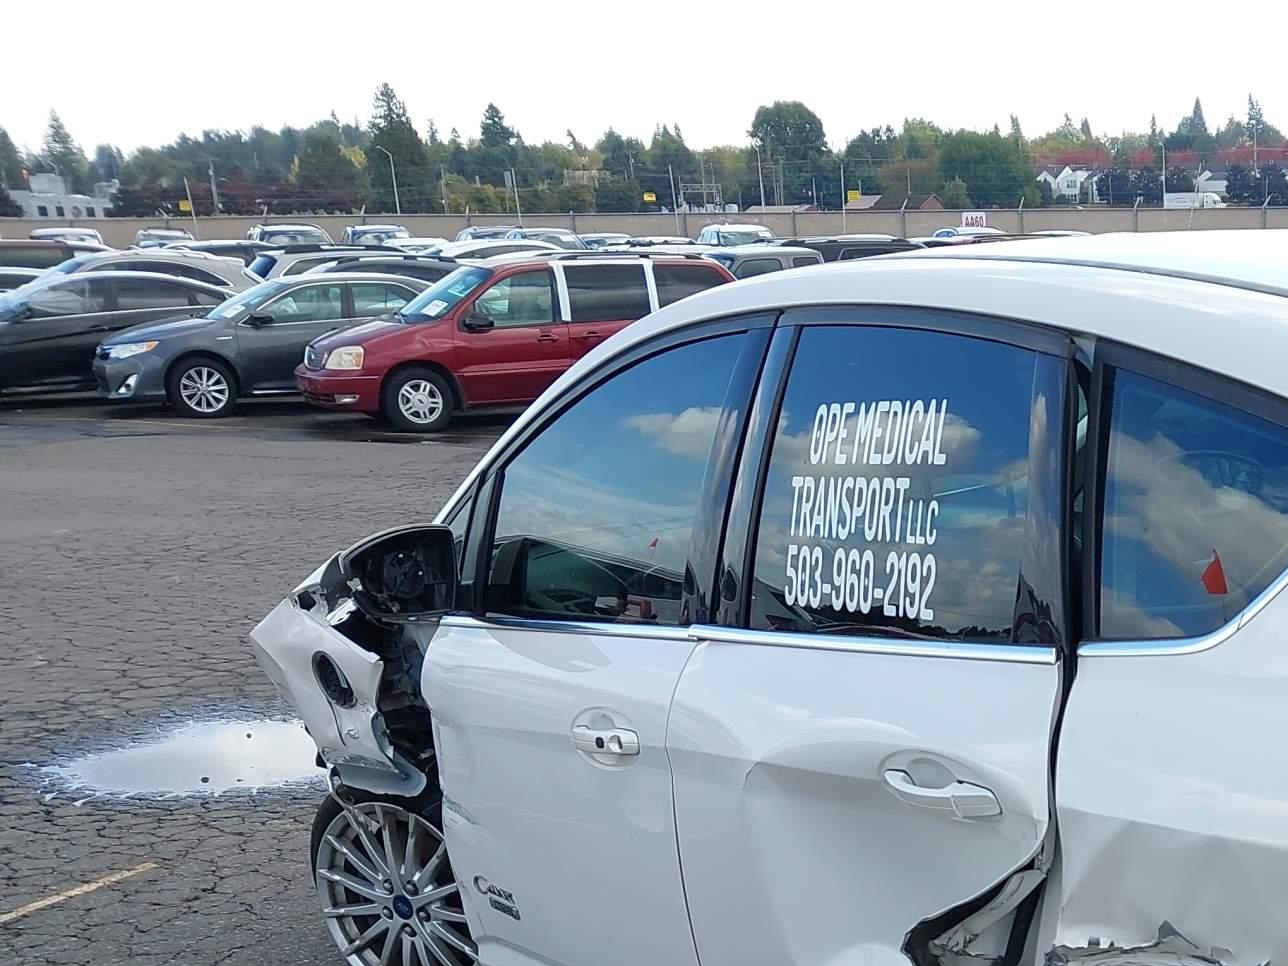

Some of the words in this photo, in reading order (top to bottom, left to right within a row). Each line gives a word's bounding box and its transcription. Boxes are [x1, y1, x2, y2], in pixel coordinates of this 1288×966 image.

[809, 402, 856, 465] OPE
[852, 398, 948, 465] MEDICAL
[789, 476, 911, 543] TRANSPORT
[906, 499, 939, 546] LLC
[784, 544, 937, 622] 503-960-2192
